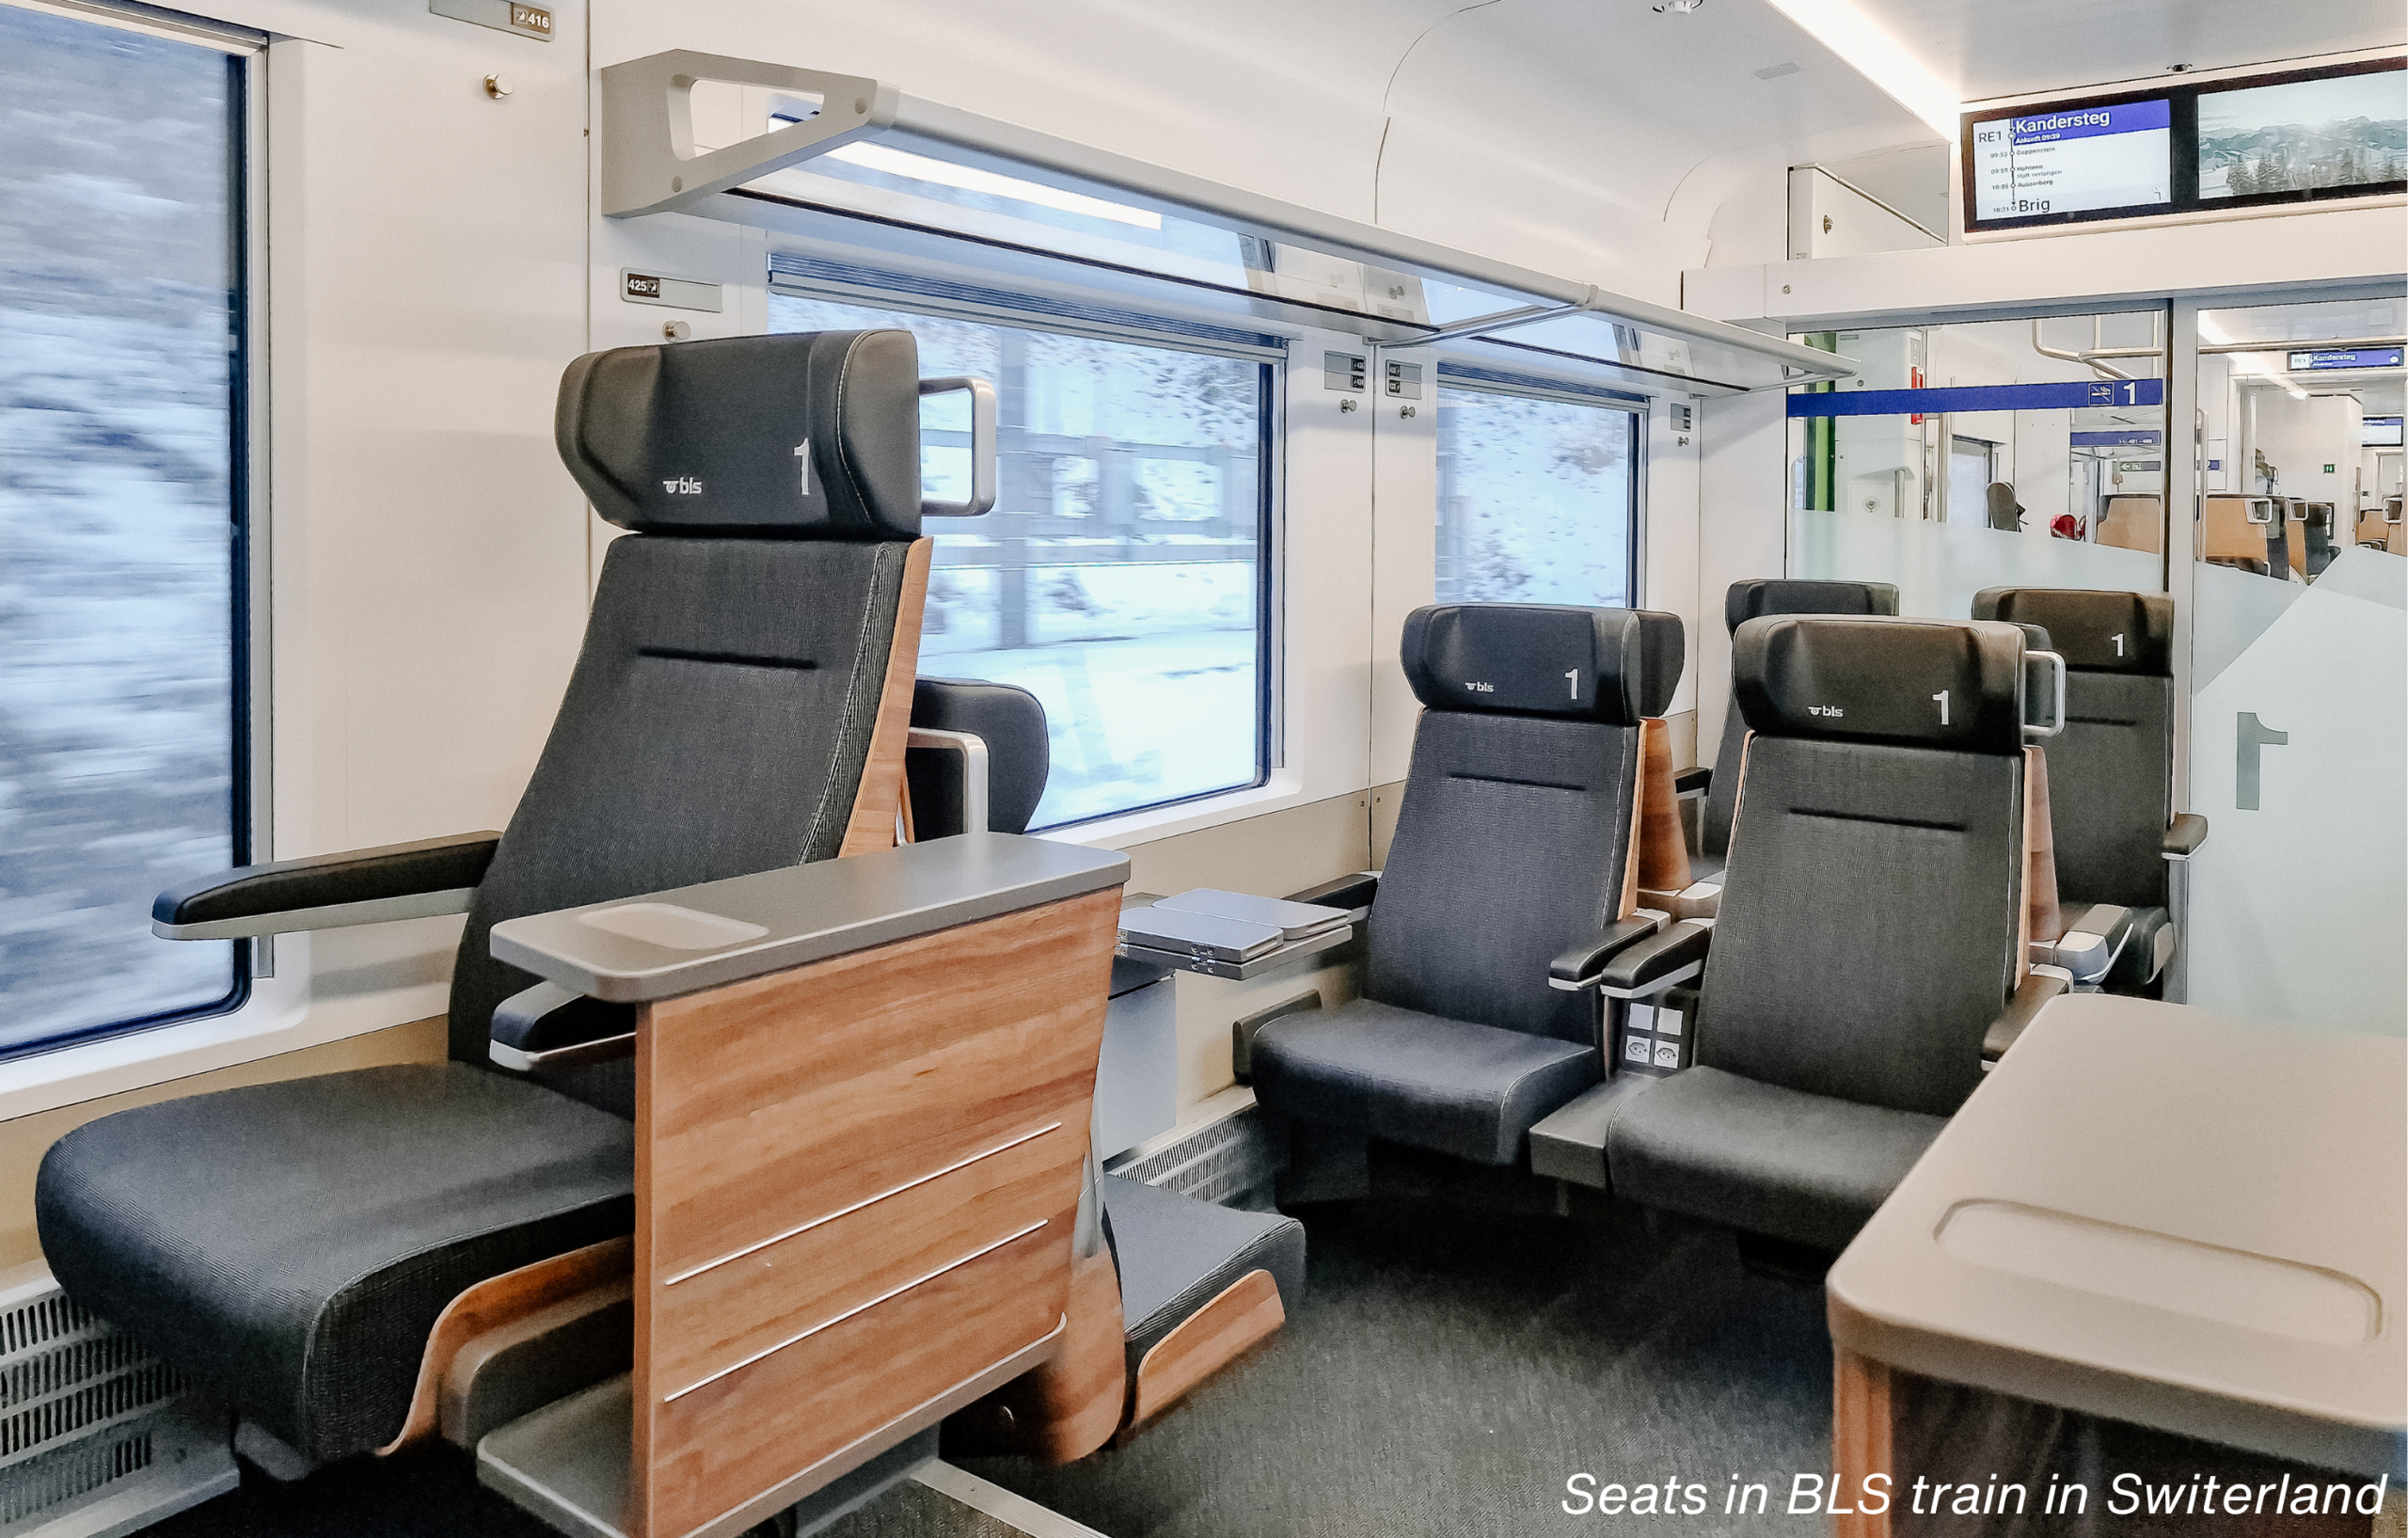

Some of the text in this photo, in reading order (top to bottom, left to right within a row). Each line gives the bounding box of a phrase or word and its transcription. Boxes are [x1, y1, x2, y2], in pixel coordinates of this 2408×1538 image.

[528, 12, 549, 28] 416
[2016, 112, 2110, 134] Kandersteg
[1978, 131, 2002, 143] RE1
[2020, 198, 2051, 213] Brig
[628, 278, 647, 292] 425
[2123, 382, 2136, 404] 1
[793, 437, 810, 496] 1
[679, 477, 703, 495] bls
[2111, 633, 2125, 657] 1
[1477, 681, 1495, 693] bls
[1564, 668, 1578, 700] 1
[1822, 706, 1844, 718] bls
[1932, 690, 1949, 725] 1
